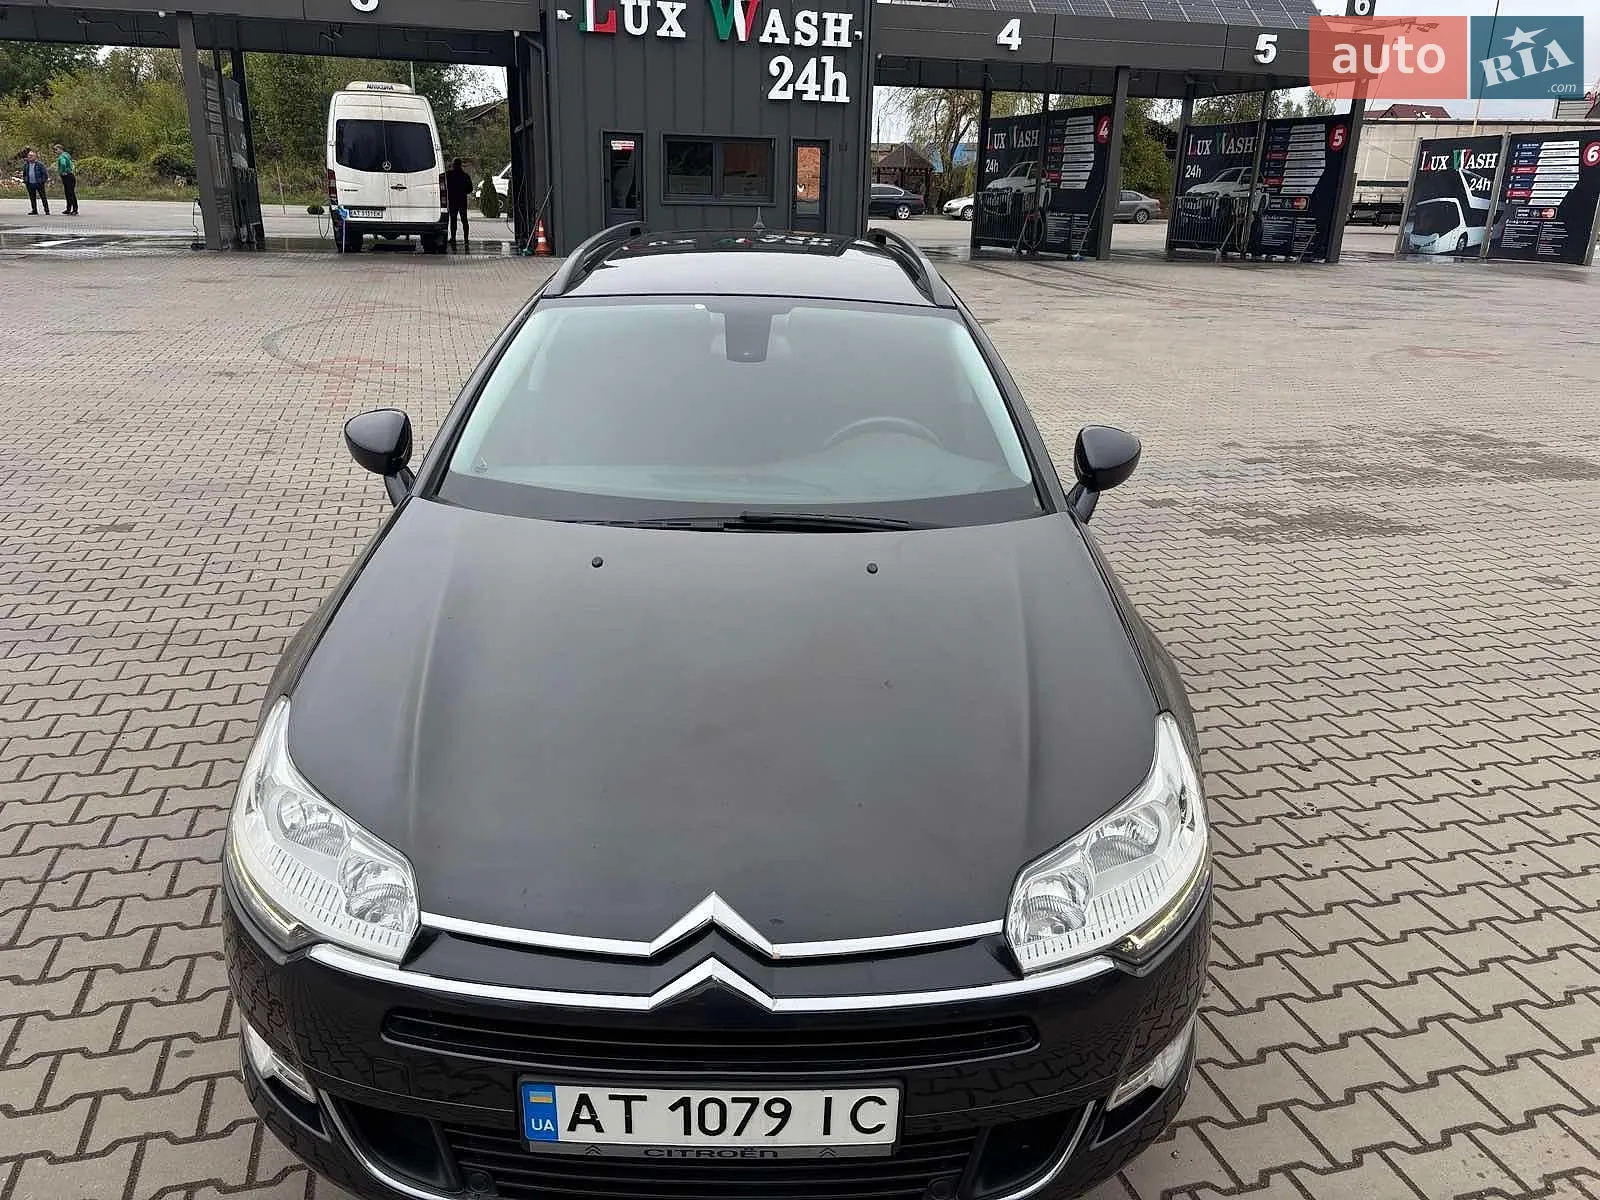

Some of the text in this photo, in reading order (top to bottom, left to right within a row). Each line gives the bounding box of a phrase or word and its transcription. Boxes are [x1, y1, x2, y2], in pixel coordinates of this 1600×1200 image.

[579, 0, 853, 48] LUX WASH
[997, 18, 1022, 51] 4
[1254, 33, 1278, 64] 5
[768, 55, 851, 103] 24h
[985, 127, 1007, 151] LUX
[1099, 120, 1109, 138] 4
[1333, 129, 1344, 146] 5
[1187, 134, 1213, 156] LUX
[1587, 145, 1600, 162] 6
[985, 159, 999, 173] 24h
[1420, 148, 1498, 171] LUX WASH
[1185, 164, 1201, 179] 24h
[1470, 177, 1491, 192] 24h
[531, 1118, 555, 1132] UA
[567, 1093, 648, 1134] AT
[668, 1096, 792, 1136] 1079
